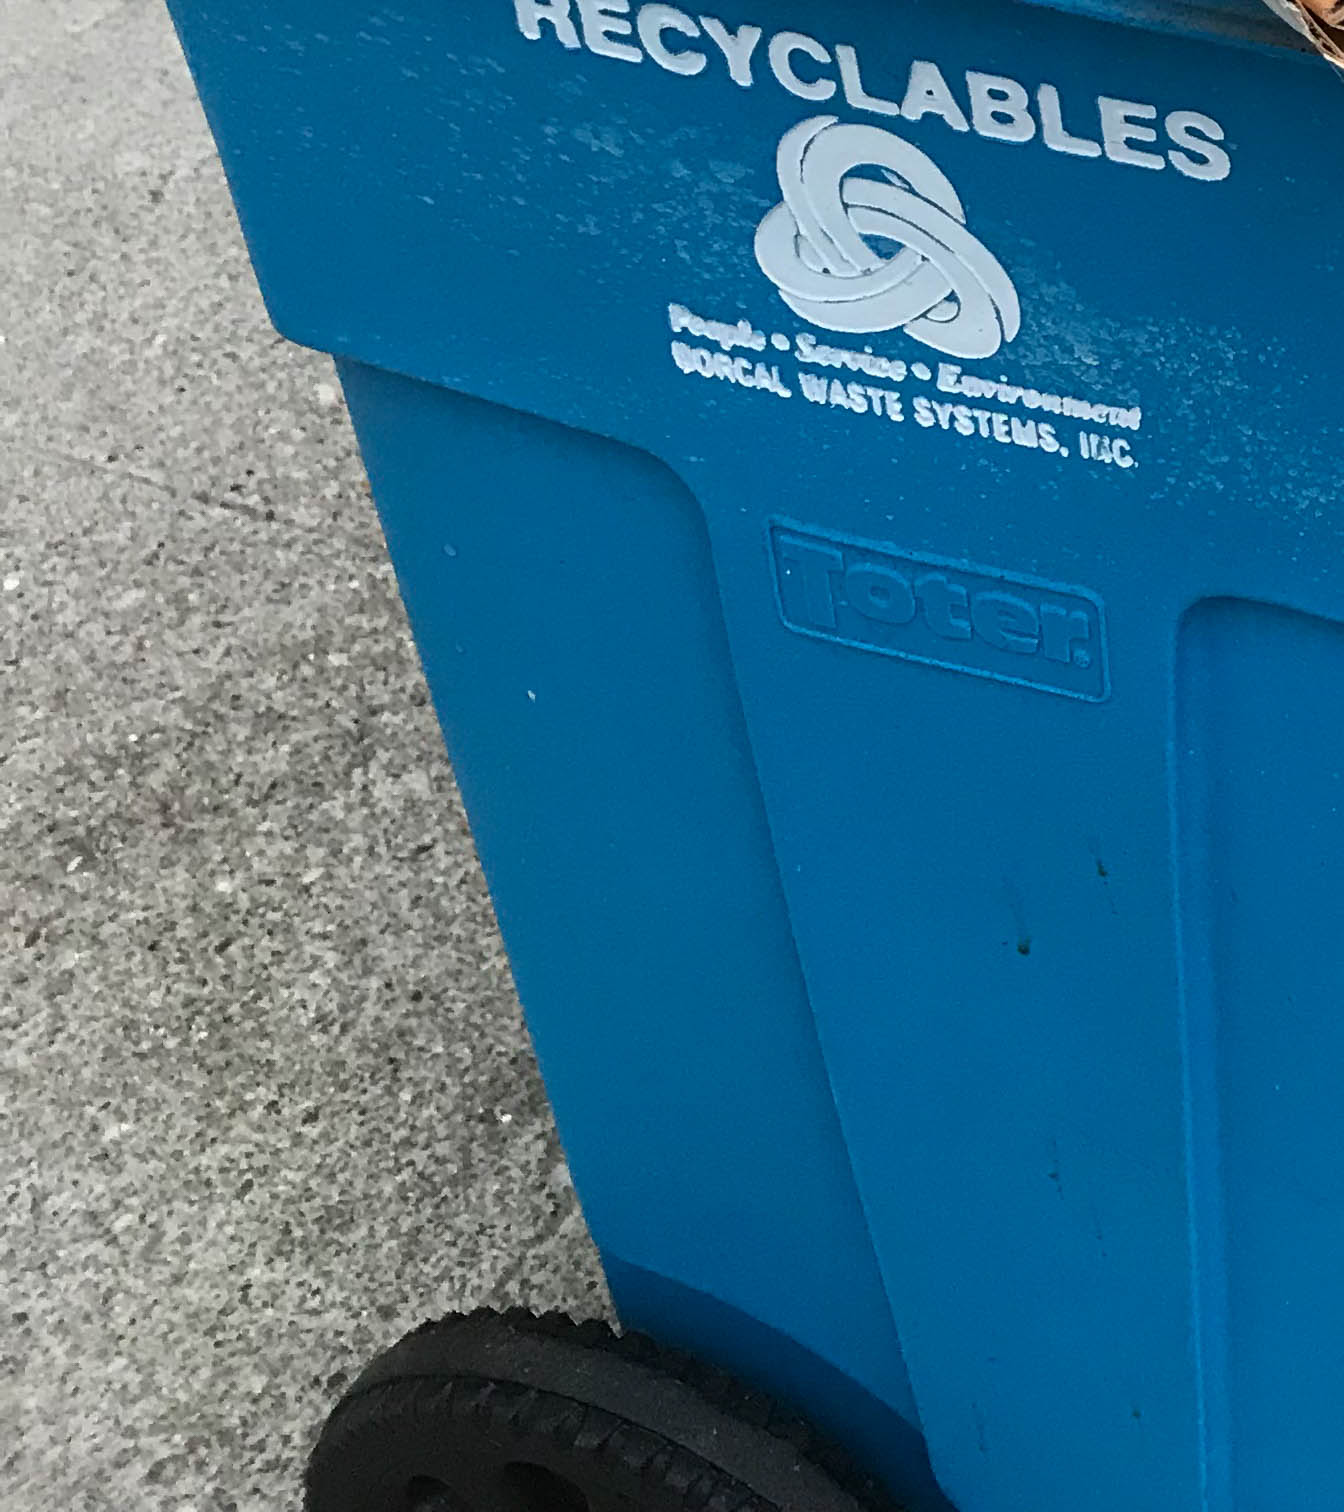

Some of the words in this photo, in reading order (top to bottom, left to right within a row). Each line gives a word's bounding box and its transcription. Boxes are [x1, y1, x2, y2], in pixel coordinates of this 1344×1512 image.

[667, 302, 767, 352] People
[795, 331, 908, 382] Service
[937, 362, 1142, 430] Environment
[797, 370, 905, 422] WASTE
